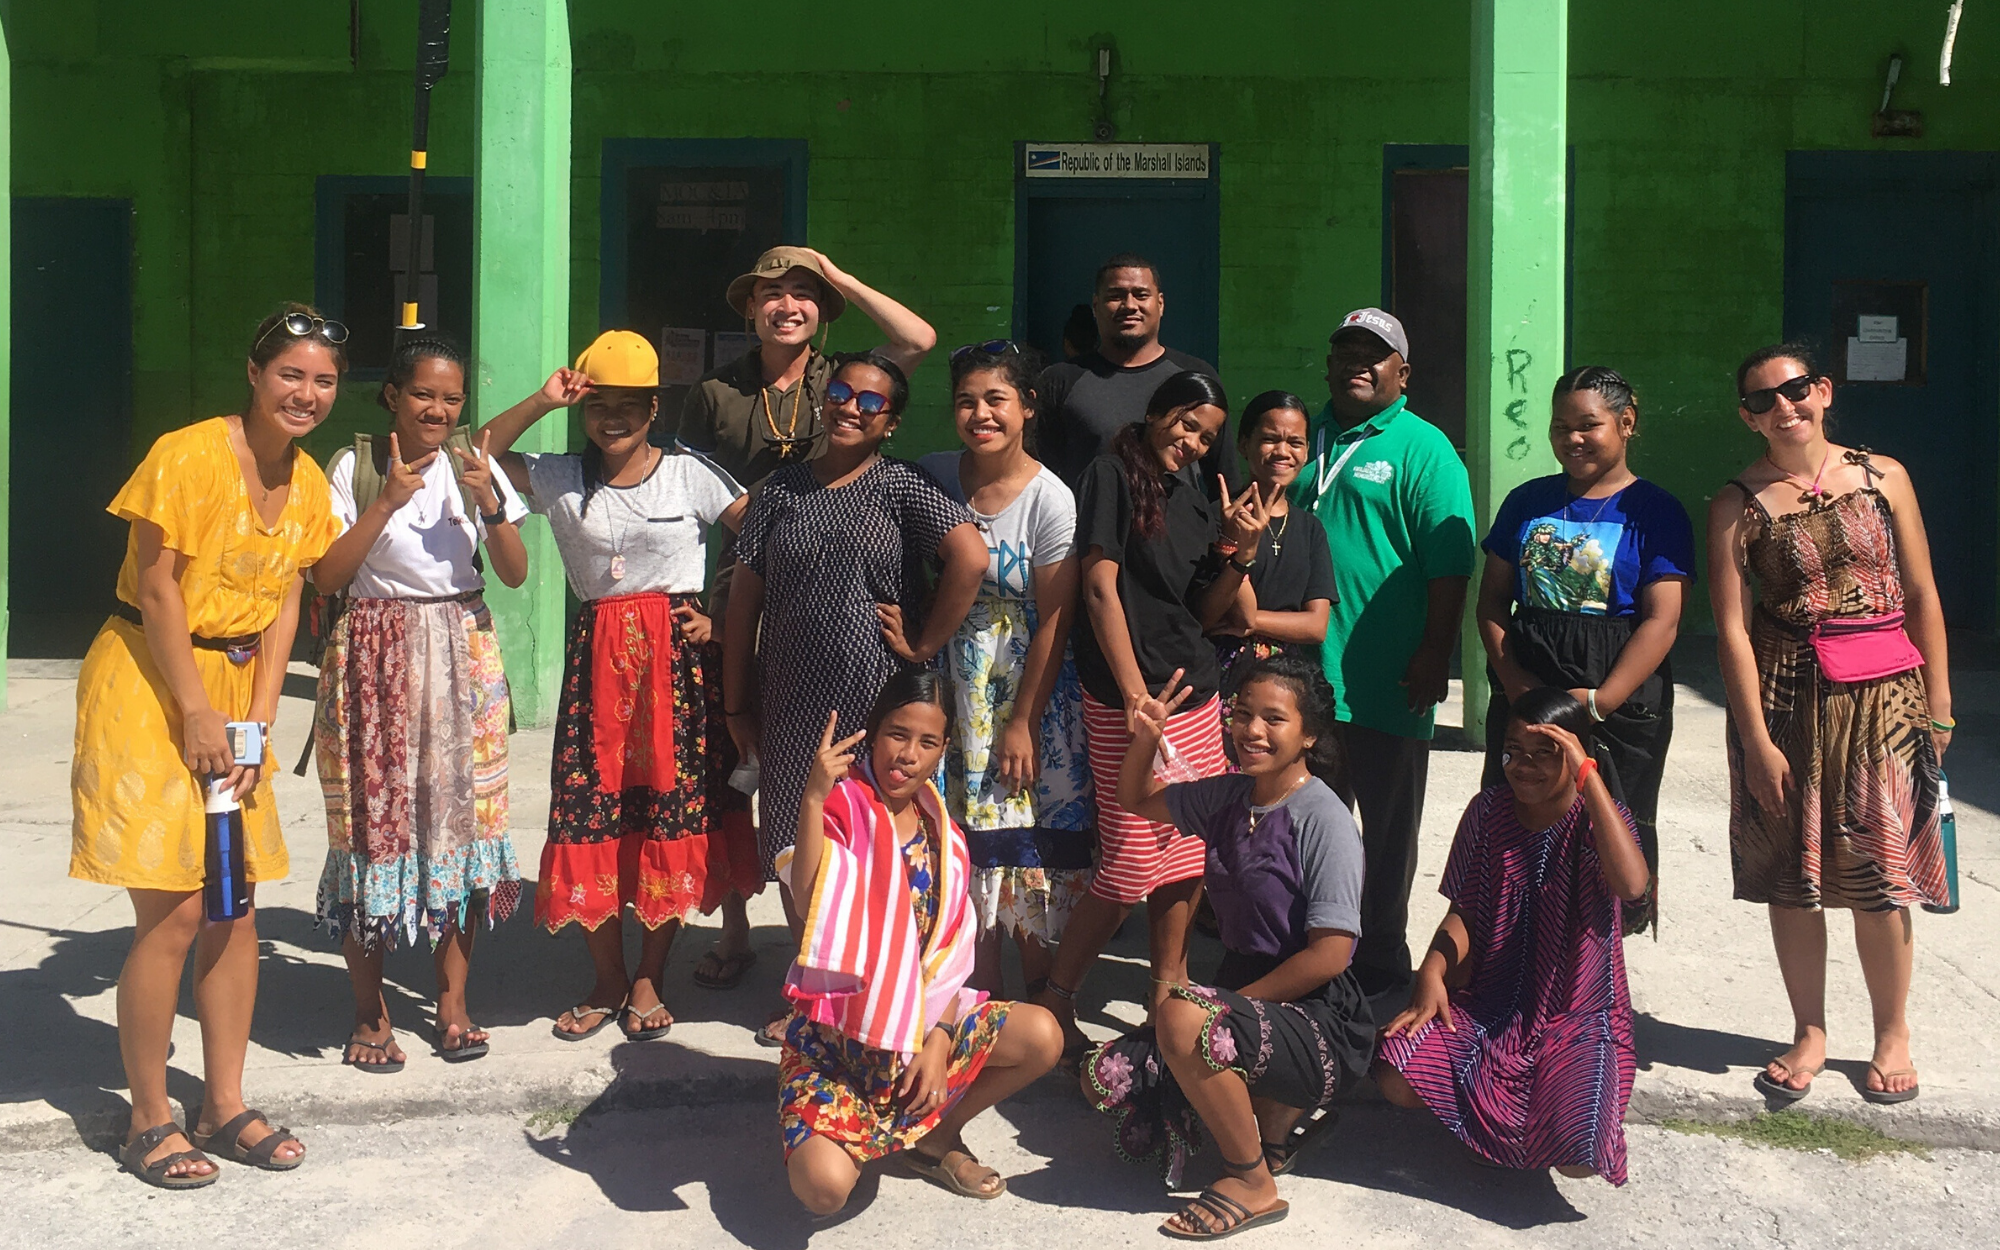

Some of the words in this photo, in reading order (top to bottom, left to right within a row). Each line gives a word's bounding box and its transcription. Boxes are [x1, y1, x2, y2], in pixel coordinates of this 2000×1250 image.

[1061, 151, 1100, 175] Republic
[1104, 152, 1113, 171] of
[1116, 152, 1131, 171] the
[1134, 152, 1171, 172] Marshall
[1175, 152, 1206, 172] Islands
[1356, 311, 1393, 333] Jesus
